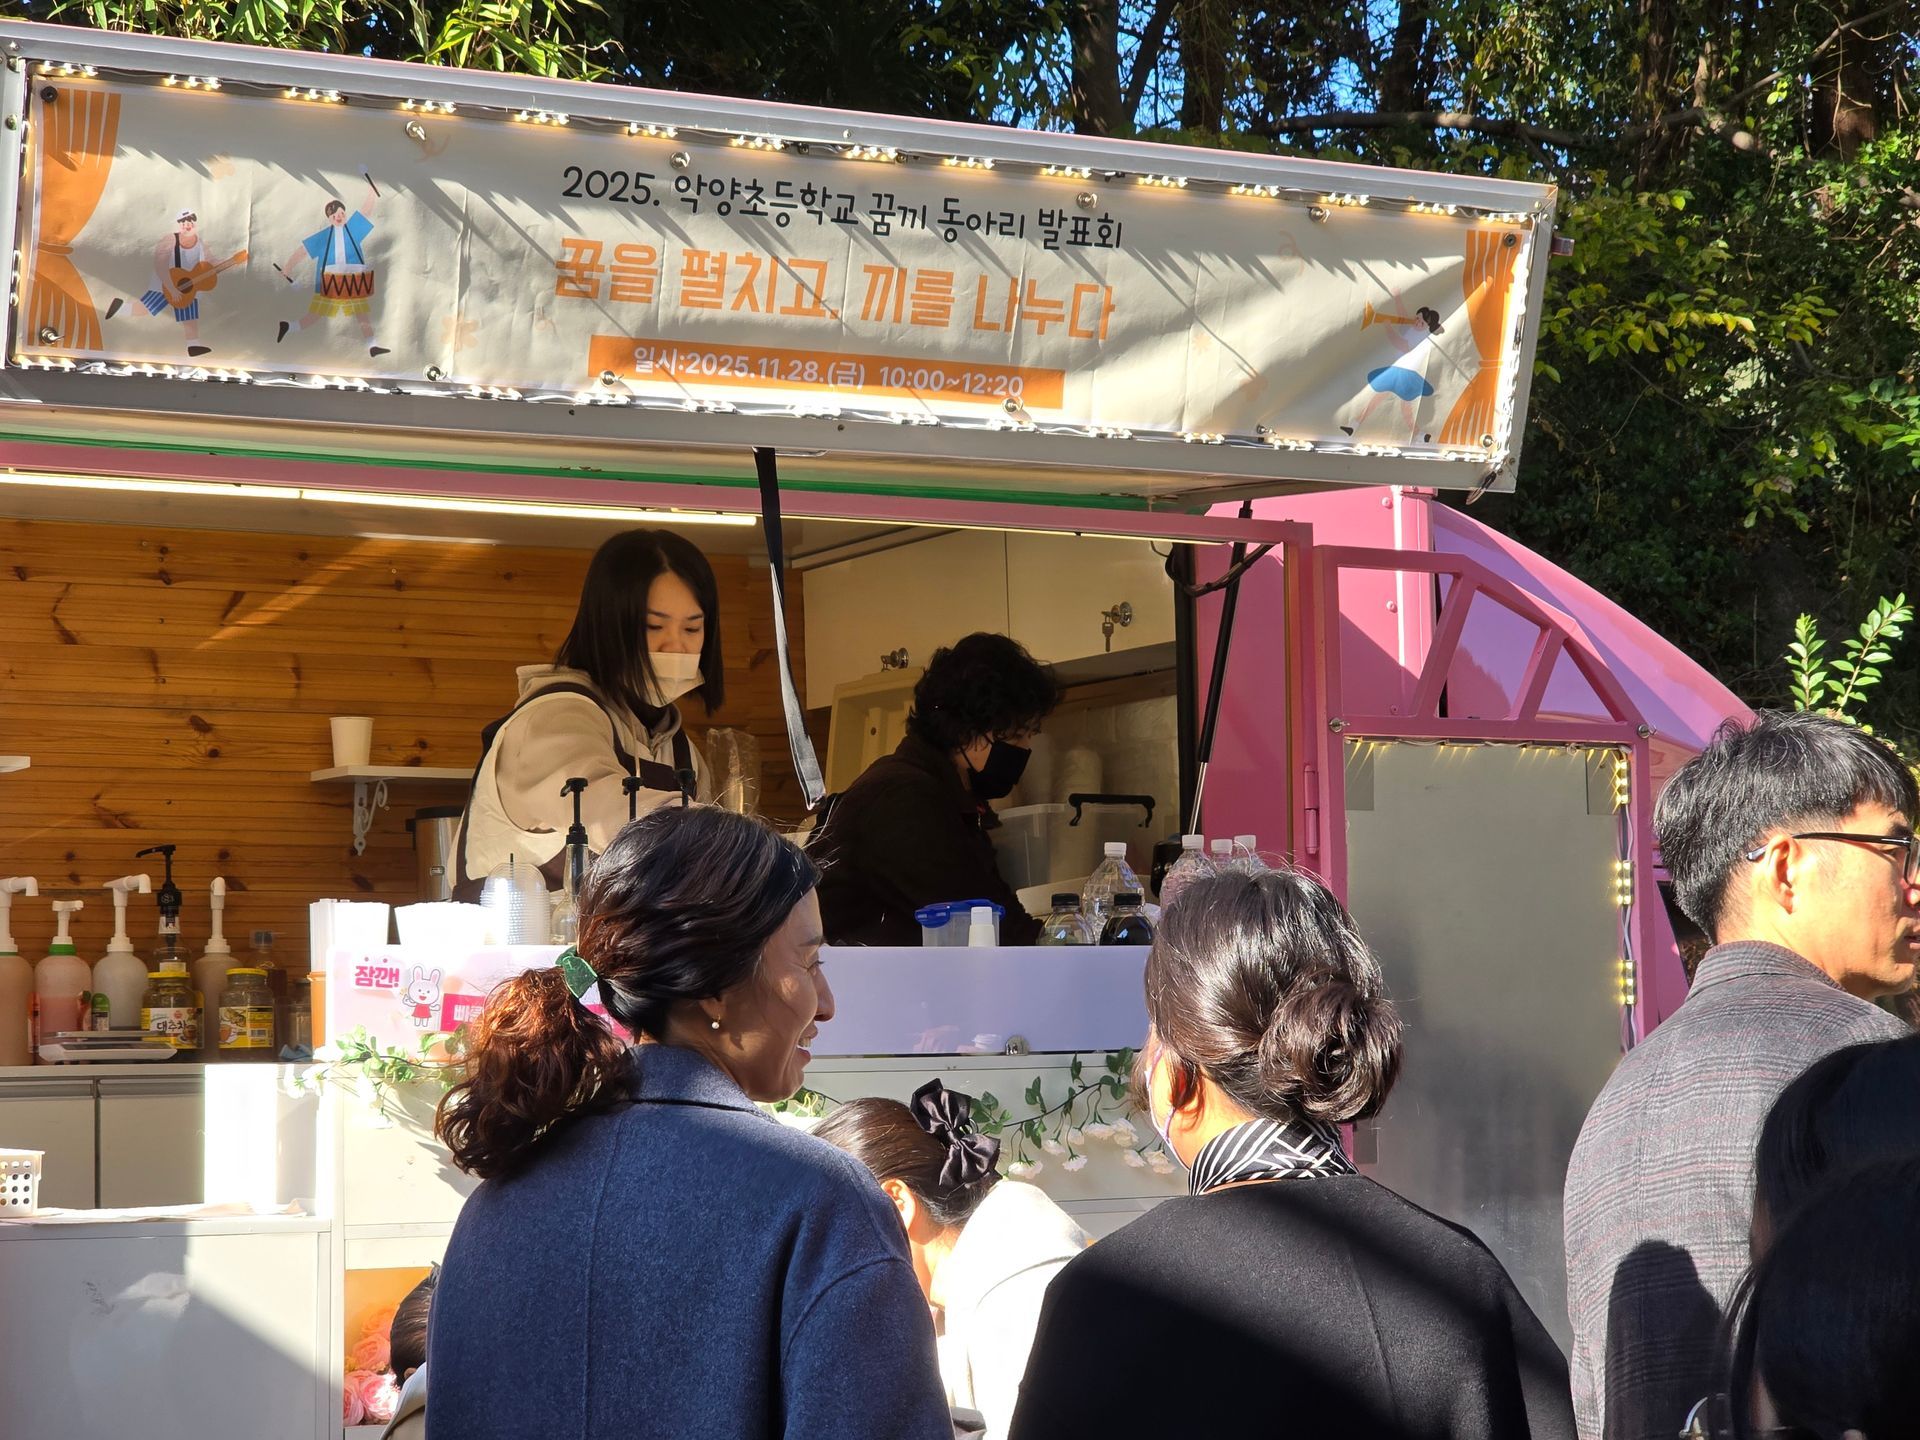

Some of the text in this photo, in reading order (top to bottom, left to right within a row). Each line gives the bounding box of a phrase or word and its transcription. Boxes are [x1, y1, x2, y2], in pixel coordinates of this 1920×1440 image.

[562, 165, 1122, 250] 2025. 악양초등학교 꿈끼 동아리 발표회
[555, 237, 658, 304] 꿈을
[860, 264, 955, 328] 끼를
[973, 274, 1116, 341] 나누다
[879, 365, 1024, 396] 10:00~12:20
[354, 965, 400, 988] 잠깐!
[156, 1019, 187, 1032] 대추차
